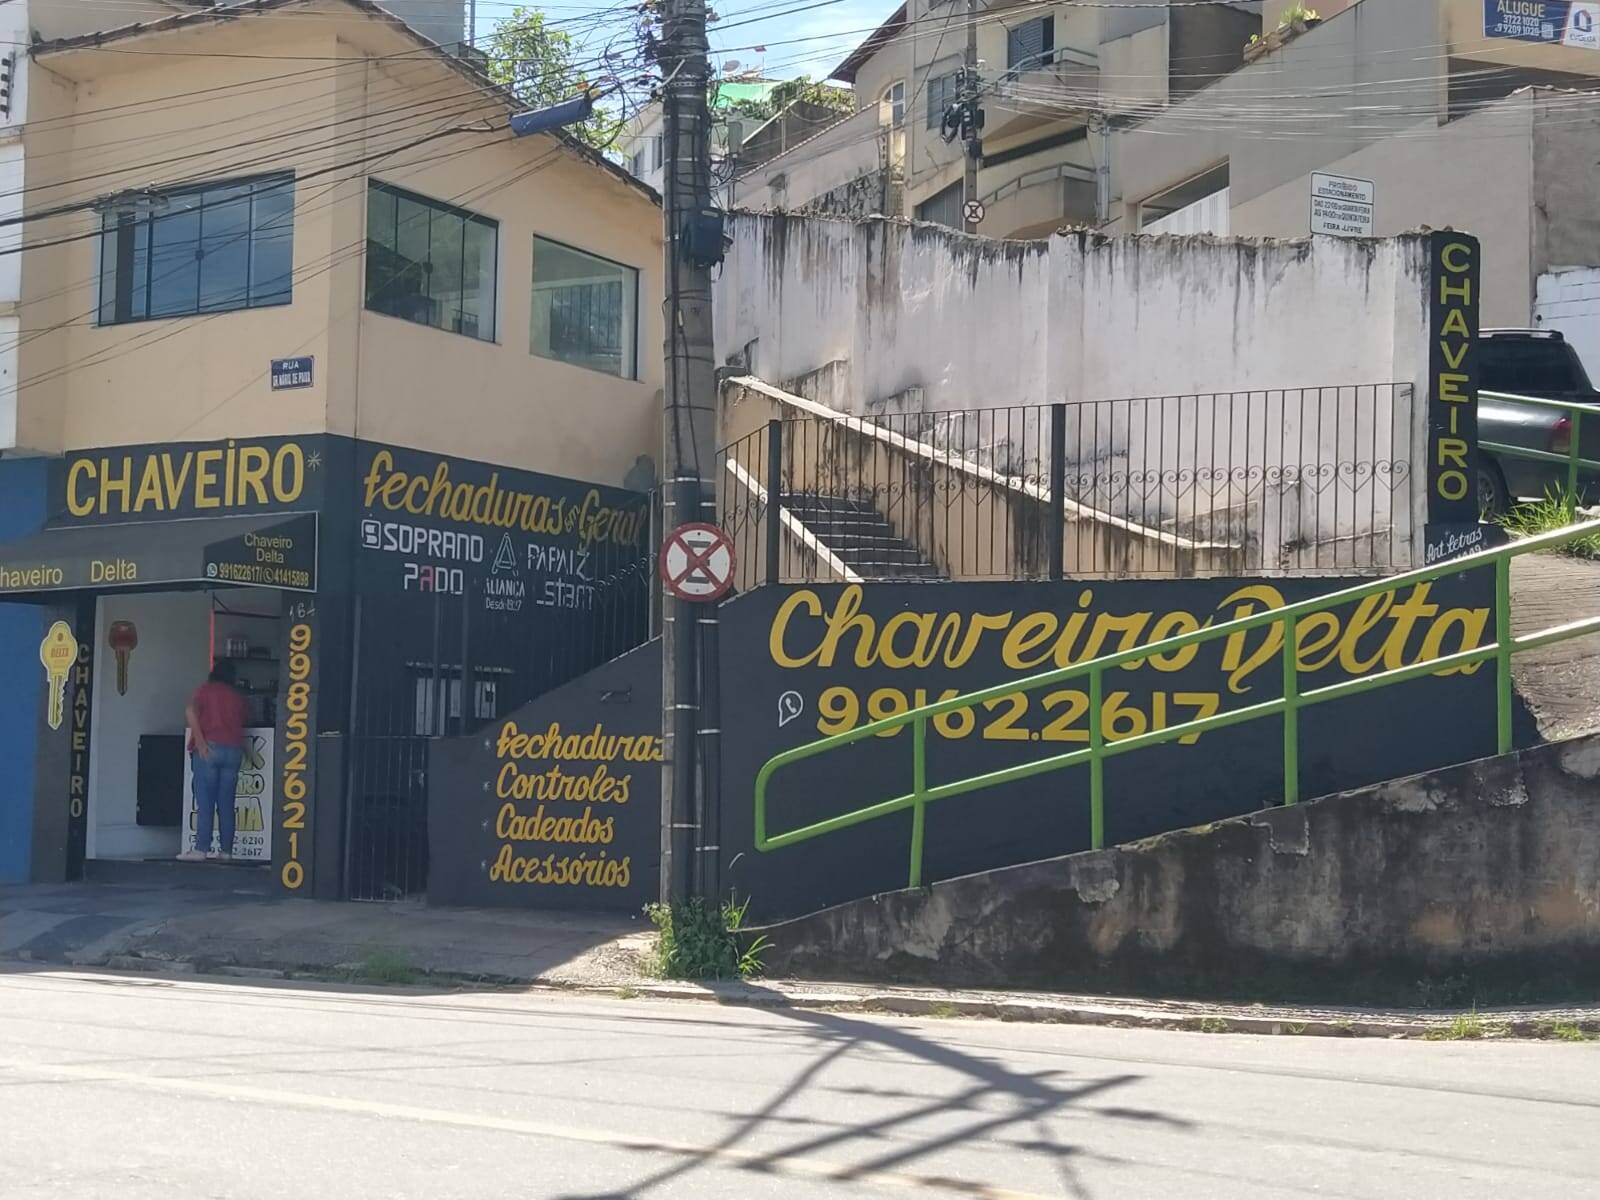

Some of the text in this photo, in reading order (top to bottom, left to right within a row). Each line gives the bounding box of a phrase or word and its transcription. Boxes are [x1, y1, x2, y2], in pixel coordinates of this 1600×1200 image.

[1497, 0, 1546, 17] ALUGUE
[1503, 14, 1539, 26] 3722 1020
[282, 360, 299, 370] RUA
[1437, 242, 1471, 501] CHAVEIRO
[244, 533, 293, 549] Chaveiro
[256, 548, 284, 563] Delta
[383, 522, 484, 563] SOPRANO
[0, 558, 137, 588] haveiro Delta
[404, 562, 464, 595] PADO
[768, 584, 1490, 694] Chaveiro Delta
[70, 643, 90, 818] CHAVEIRO
[496, 762, 632, 803] Controles
[496, 802, 614, 843] Cadeados
[489, 844, 631, 888] Acessórios
